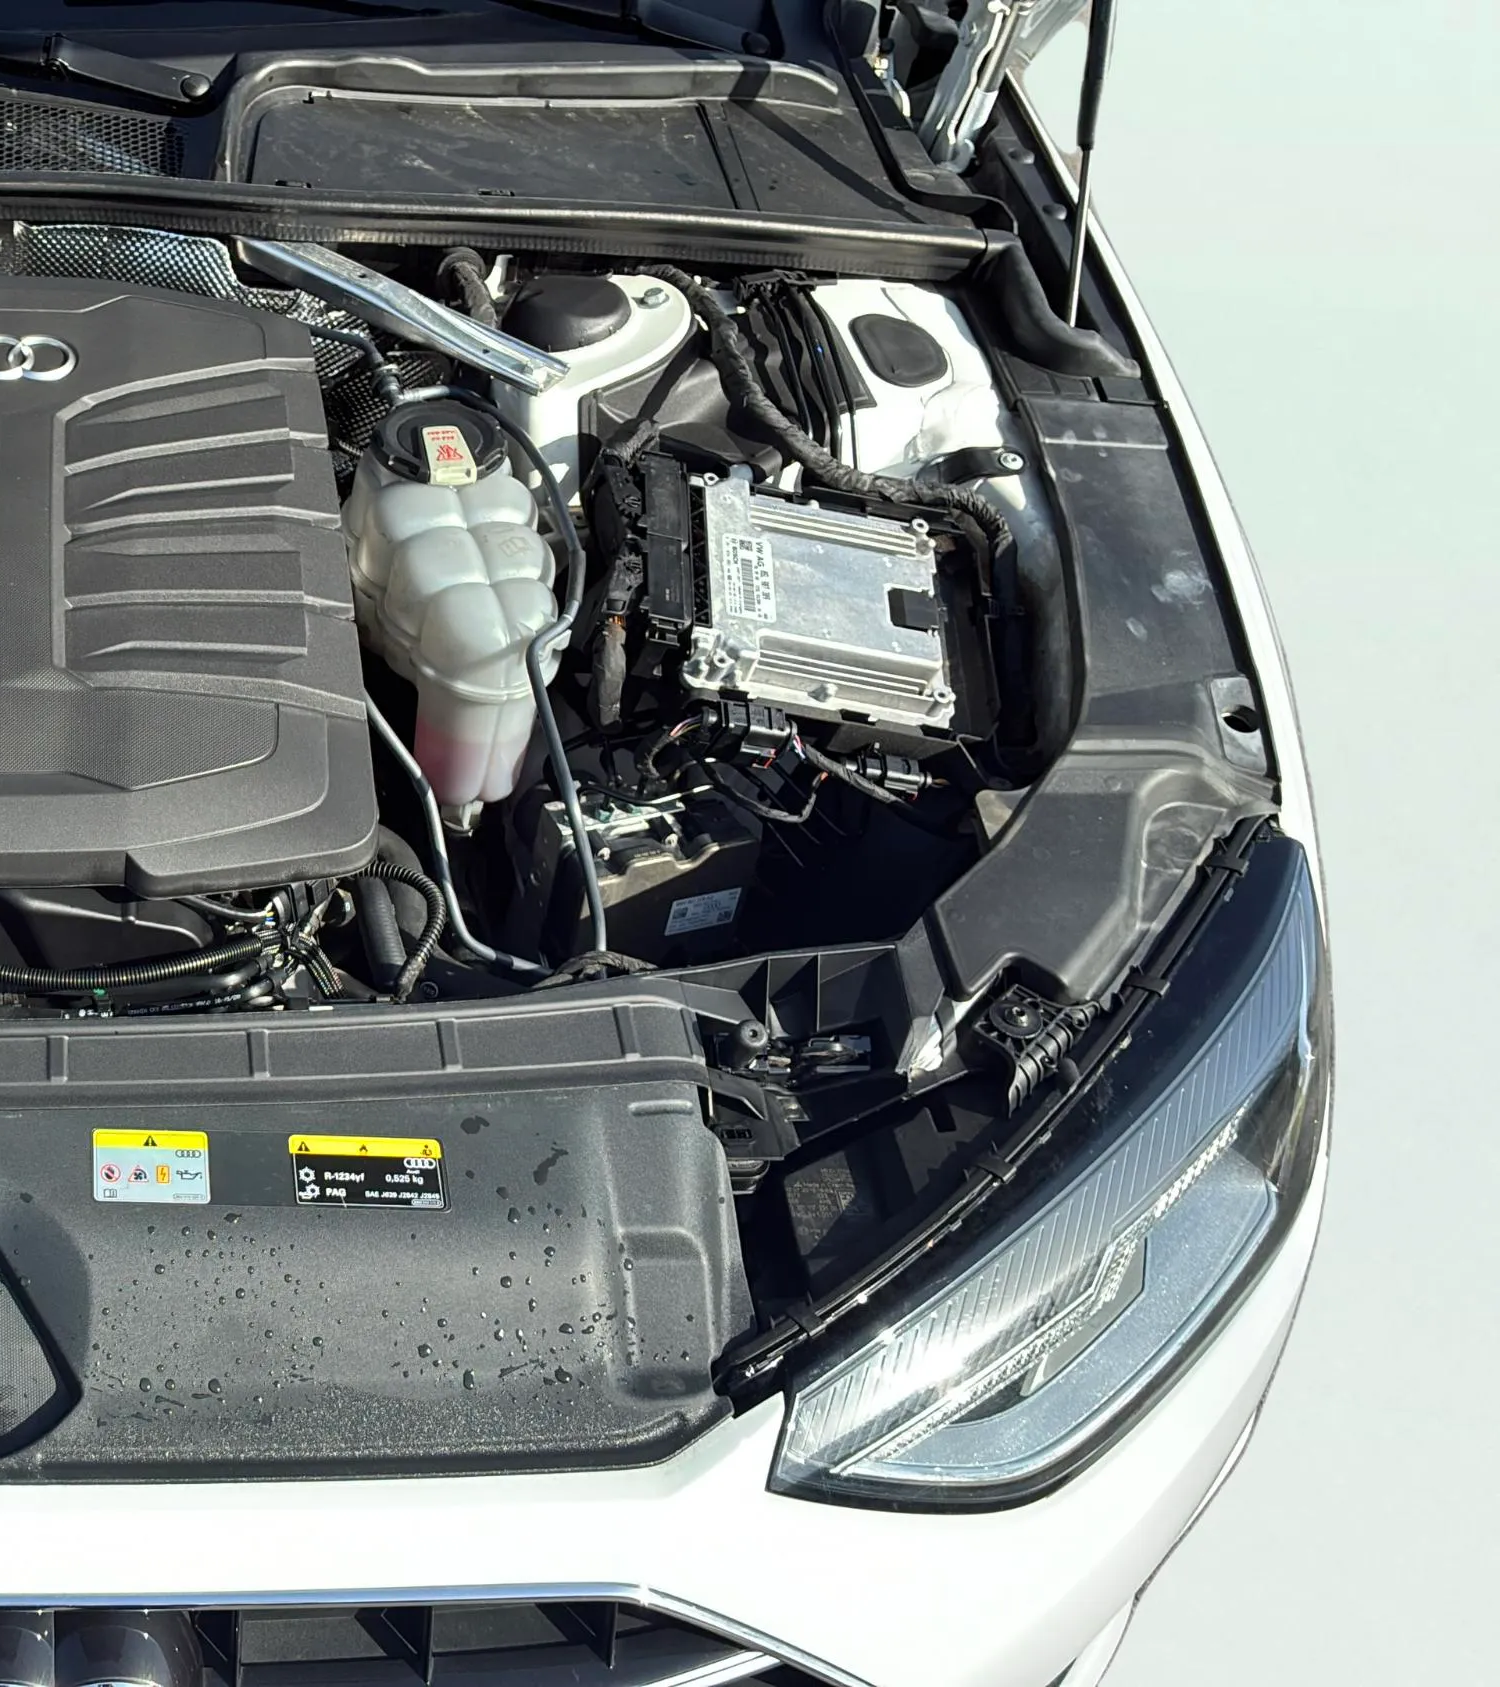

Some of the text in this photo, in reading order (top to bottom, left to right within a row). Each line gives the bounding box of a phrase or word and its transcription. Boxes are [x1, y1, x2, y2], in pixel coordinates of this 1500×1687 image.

[755, 542, 764, 554] VW
[756, 556, 765, 567] AG
[324, 1171, 424, 1185] R-1234yf 0,525 kg
[326, 1187, 347, 1197] PAG
